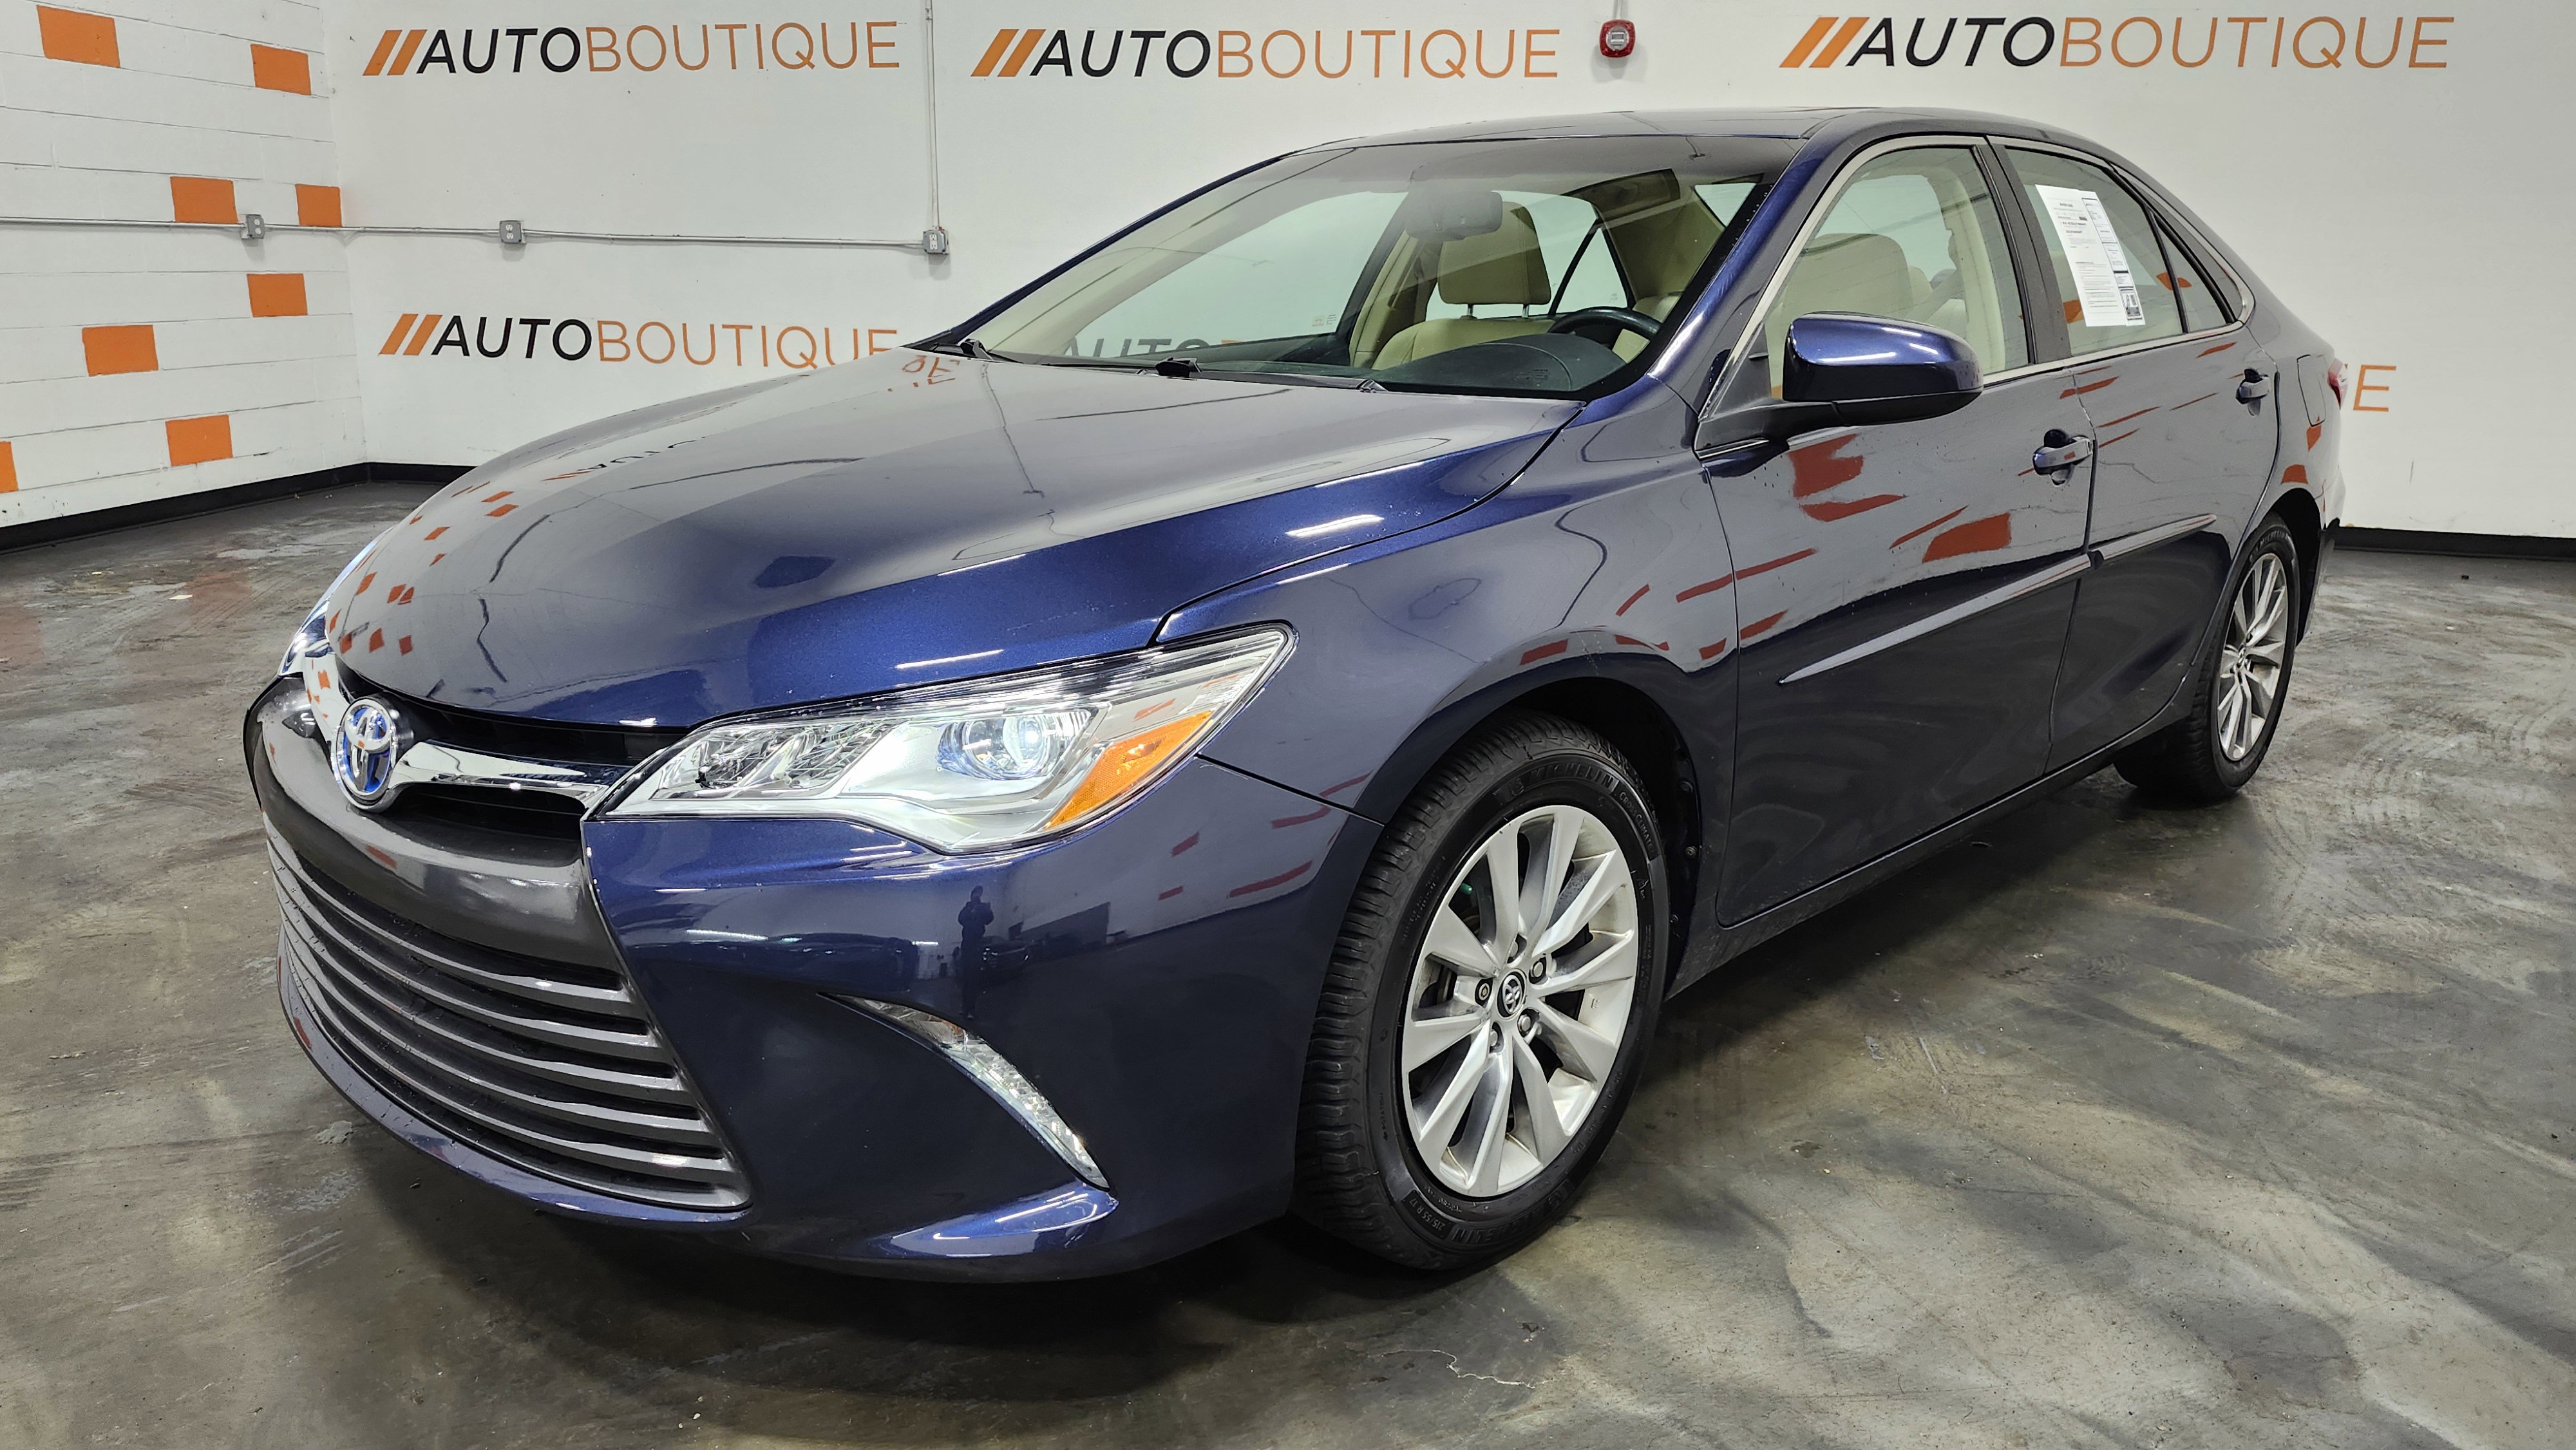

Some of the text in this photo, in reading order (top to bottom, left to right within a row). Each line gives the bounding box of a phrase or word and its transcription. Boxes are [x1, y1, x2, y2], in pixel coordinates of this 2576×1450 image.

[417, 22, 900, 74] AUTOBOUTIQUE
[1030, 29, 1560, 79] AUTOBOUTIQUE
[1846, 17, 2455, 68] AUTOBOUTIQUE
[1408, 1198, 1417, 1207] 17
[1421, 1210, 1446, 1230] 215/55
